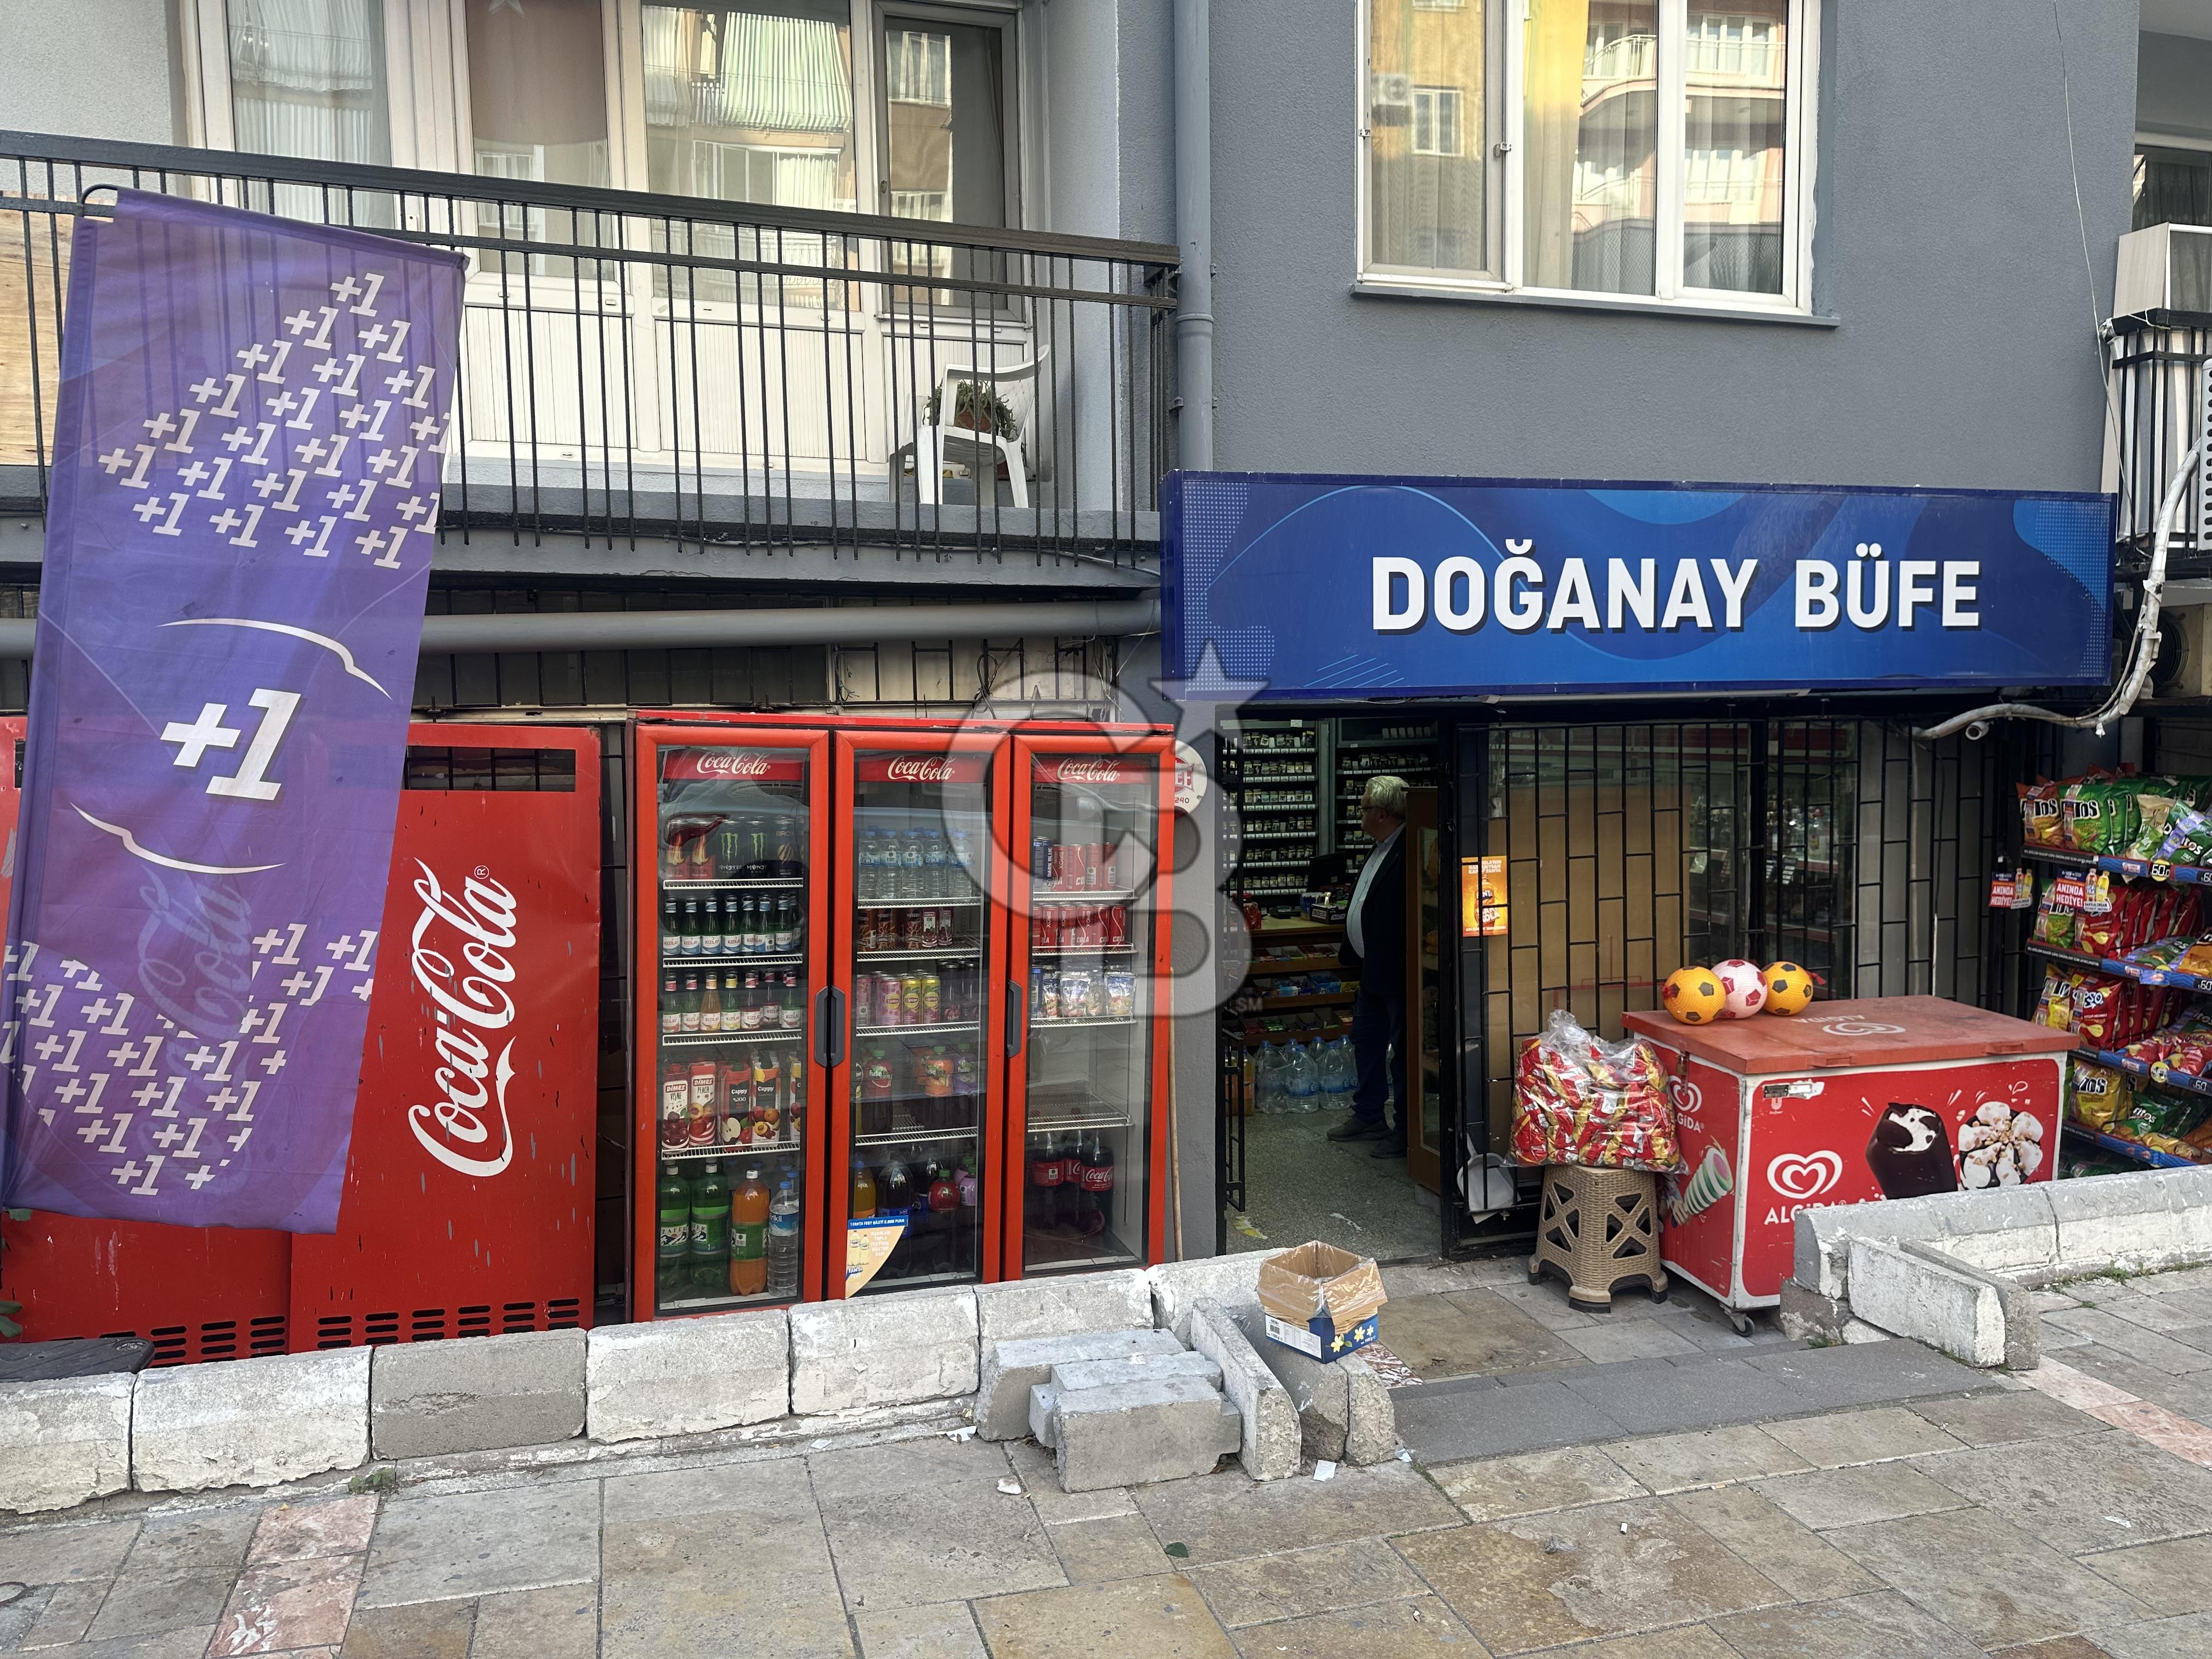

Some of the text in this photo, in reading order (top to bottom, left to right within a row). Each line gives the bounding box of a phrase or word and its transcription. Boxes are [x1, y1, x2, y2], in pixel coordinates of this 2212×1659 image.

[330, 273, 385, 317] +1
[283, 307, 338, 351] +1
[358, 320, 410, 363] +1
[236, 340, 294, 384] +1
[312, 354, 365, 397] +1
[189, 374, 246, 417] +1
[266, 387, 320, 430] +1
[384, 365, 436, 409] +1
[143, 409, 200, 454] +1
[339, 399, 391, 441] +1
[221, 422, 276, 465] +1
[295, 434, 350, 477] +1
[98, 444, 156, 489] +1
[177, 457, 233, 500] +1
[366, 445, 420, 488] +1
[252, 469, 307, 512] +1
[326, 479, 380, 522] +1
[132, 493, 189, 537] +1
[208, 504, 265, 548] +1
[284, 516, 337, 557] +1
[355, 526, 408, 569] +1
[1373, 539, 1980, 631] DOĞANAY BÜFE
[160, 687, 302, 801] +1
[697, 751, 770, 775] Coca-Cola
[888, 755, 955, 781] Coca-Cola
[1057, 758, 1121, 782] Coca-Cola
[2056, 883, 2084, 896] ANINDA
[2056, 894, 2083, 907] HEDİYE!
[254, 923, 307, 965] +1
[326, 929, 375, 972] +1
[15, 984, 64, 1028] +1
[80, 992, 135, 1036] +1
[408, 857, 517, 1177] Coca-Cola
[34, 1029, 88, 1073] +1
[106, 1035, 165, 1076] +1
[184, 1040, 240, 1082] +1
[54, 1073, 110, 1114] +1
[131, 1076, 188, 1118] +1
[205, 1080, 262, 1122] +1
[76, 1113, 134, 1154] +1
[152, 1118, 208, 1159] +1
[110, 1154, 166, 1196] +1
